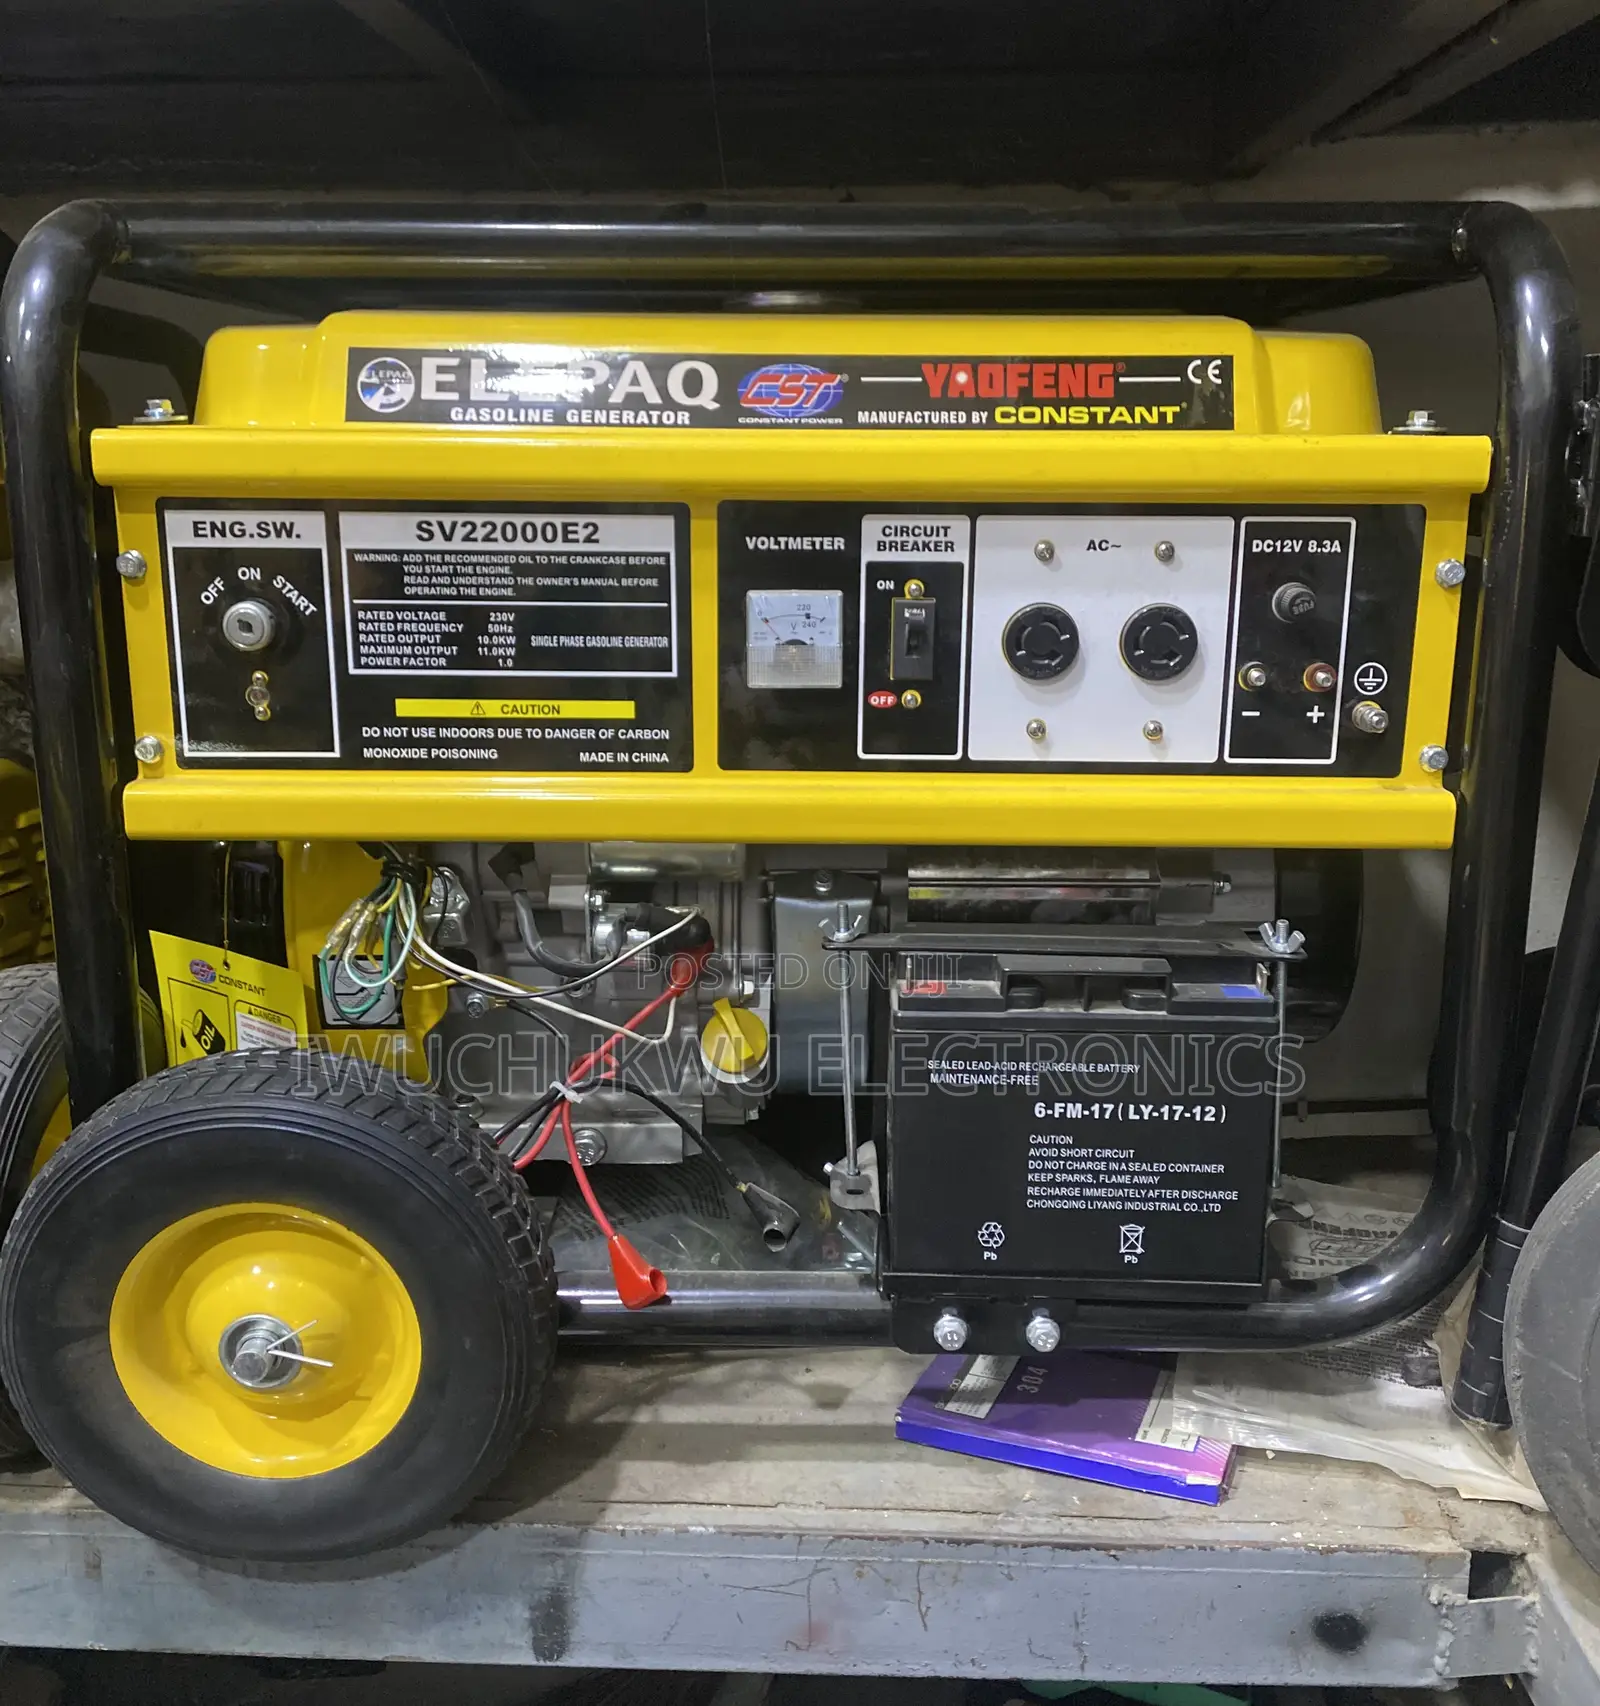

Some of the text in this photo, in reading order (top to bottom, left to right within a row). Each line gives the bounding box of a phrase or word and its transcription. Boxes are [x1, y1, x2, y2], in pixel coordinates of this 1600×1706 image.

[1187, 359, 1222, 384] CE
[740, 373, 841, 408] CST
[450, 406, 691, 425] GASOLINE GENERATOR
[857, 406, 1180, 424] MANUFACTURED BY CONSTANT
[192, 521, 301, 538] ENG.SW.
[415, 520, 600, 543] SV22000E2
[881, 525, 951, 538] CIRCUIT
[745, 536, 845, 550] VOLTMETER
[876, 540, 955, 553] BREAKER
[1252, 540, 1342, 553] DC12V 8.3A
[354, 553, 666, 565] WARNING: ADD THE RECOMMENDED OIL TO THE CRANKCASE BEFORE
[237, 567, 261, 581] ON
[403, 565, 513, 574] YOU START THE ENGINE.
[404, 575, 659, 587] READ AND UNDERSTAND THE OWNER'S MANUAL BEFORE
[876, 580, 895, 590] ON
[200, 576, 225, 605] OFF
[272, 575, 317, 616] START
[404, 586, 516, 596] OPERATING THE ENGINE.
[358, 611, 515, 622] RATED VOLTAGE 230V
[358, 622, 513, 633] RATED FREQUENCY 50Hz
[802, 621, 817, 629] 240
[359, 634, 516, 645] RATED OUTPUT 10.0KW
[531, 635, 669, 648] SINGLE PHASE GASOLINE GENERATOR
[360, 645, 516, 657] MAXIMUM OUTPUT 11.0KW
[360, 656, 513, 668] POWER FACTOR 1.0
[870, 696, 895, 706] OFF
[500, 704, 561, 716] CAUTION
[362, 727, 670, 740] DO NOT USE INDOORS DUE TO DANGER OF CARBON
[363, 748, 670, 763] MONOXIDE POISONING MADE IN CHINA
[219, 974, 266, 997] CONSTANT
[201, 1025, 215, 1050] OIL
[928, 1060, 1141, 1074] SEALED LEAD-ACID RECHARGEABLE BATTERY
[930, 1073, 1039, 1086] MAINTENANCE-FREE
[1029, 1135, 1074, 1145] CAUTION
[1028, 1148, 1135, 1159] AVOID SHORT CIRCUIT
[1028, 1160, 1225, 1174] DO NOT CHARGE IN A SEALED CONTAINER
[1028, 1174, 1161, 1185] KEEP SPARKS, FLAME AWAY
[1027, 1186, 1239, 1201] RECHARGE IMMEDIATELY AFTER DISCHARGE
[1026, 1200, 1087, 1211] CHONGQING
[1088, 1201, 1123, 1211] LIYANG
[1124, 1202, 1182, 1212] INDUSTRIAL
[983, 1252, 998, 1261] Pb
[1124, 1255, 1139, 1265] Pb
[1016, 1366, 1049, 1393] 304
